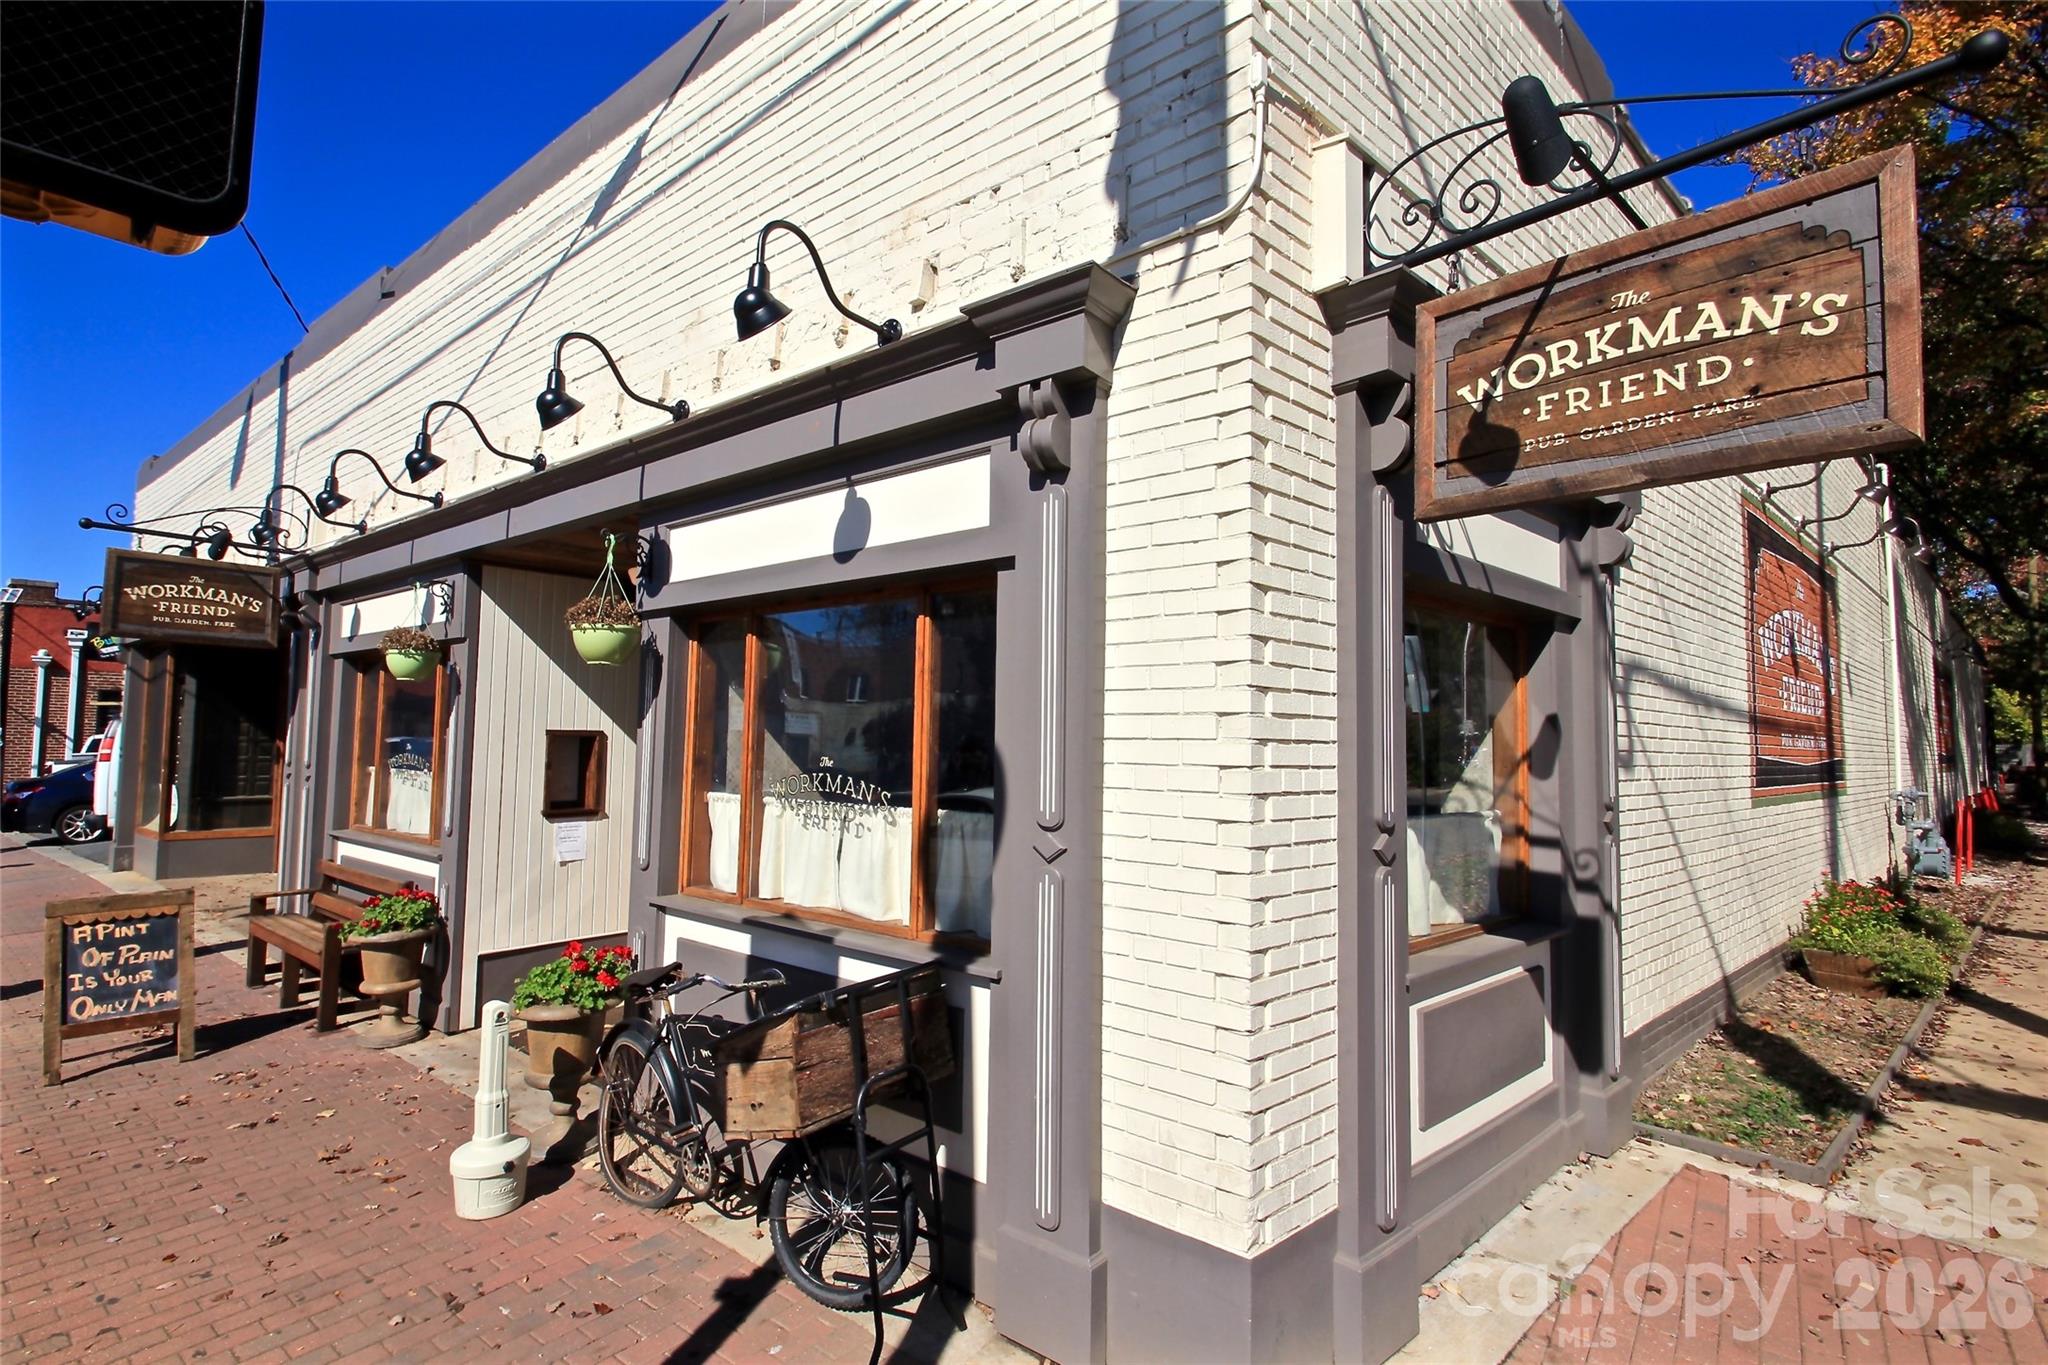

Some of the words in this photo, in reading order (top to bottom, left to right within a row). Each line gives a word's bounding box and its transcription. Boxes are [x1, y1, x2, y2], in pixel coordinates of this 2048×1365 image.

[1610, 289, 1651, 314] The
[1456, 292, 1849, 415] WORKMAN'S
[1523, 432, 1569, 453] PUB.
[1579, 410, 1682, 441] GARDEN.
[188, 575, 205, 585] The
[123, 584, 264, 613] WORKMAN'S
[819, 756, 834, 768] The
[769, 772, 892, 811] WORKMAN'S
[73, 924, 93, 945] A
